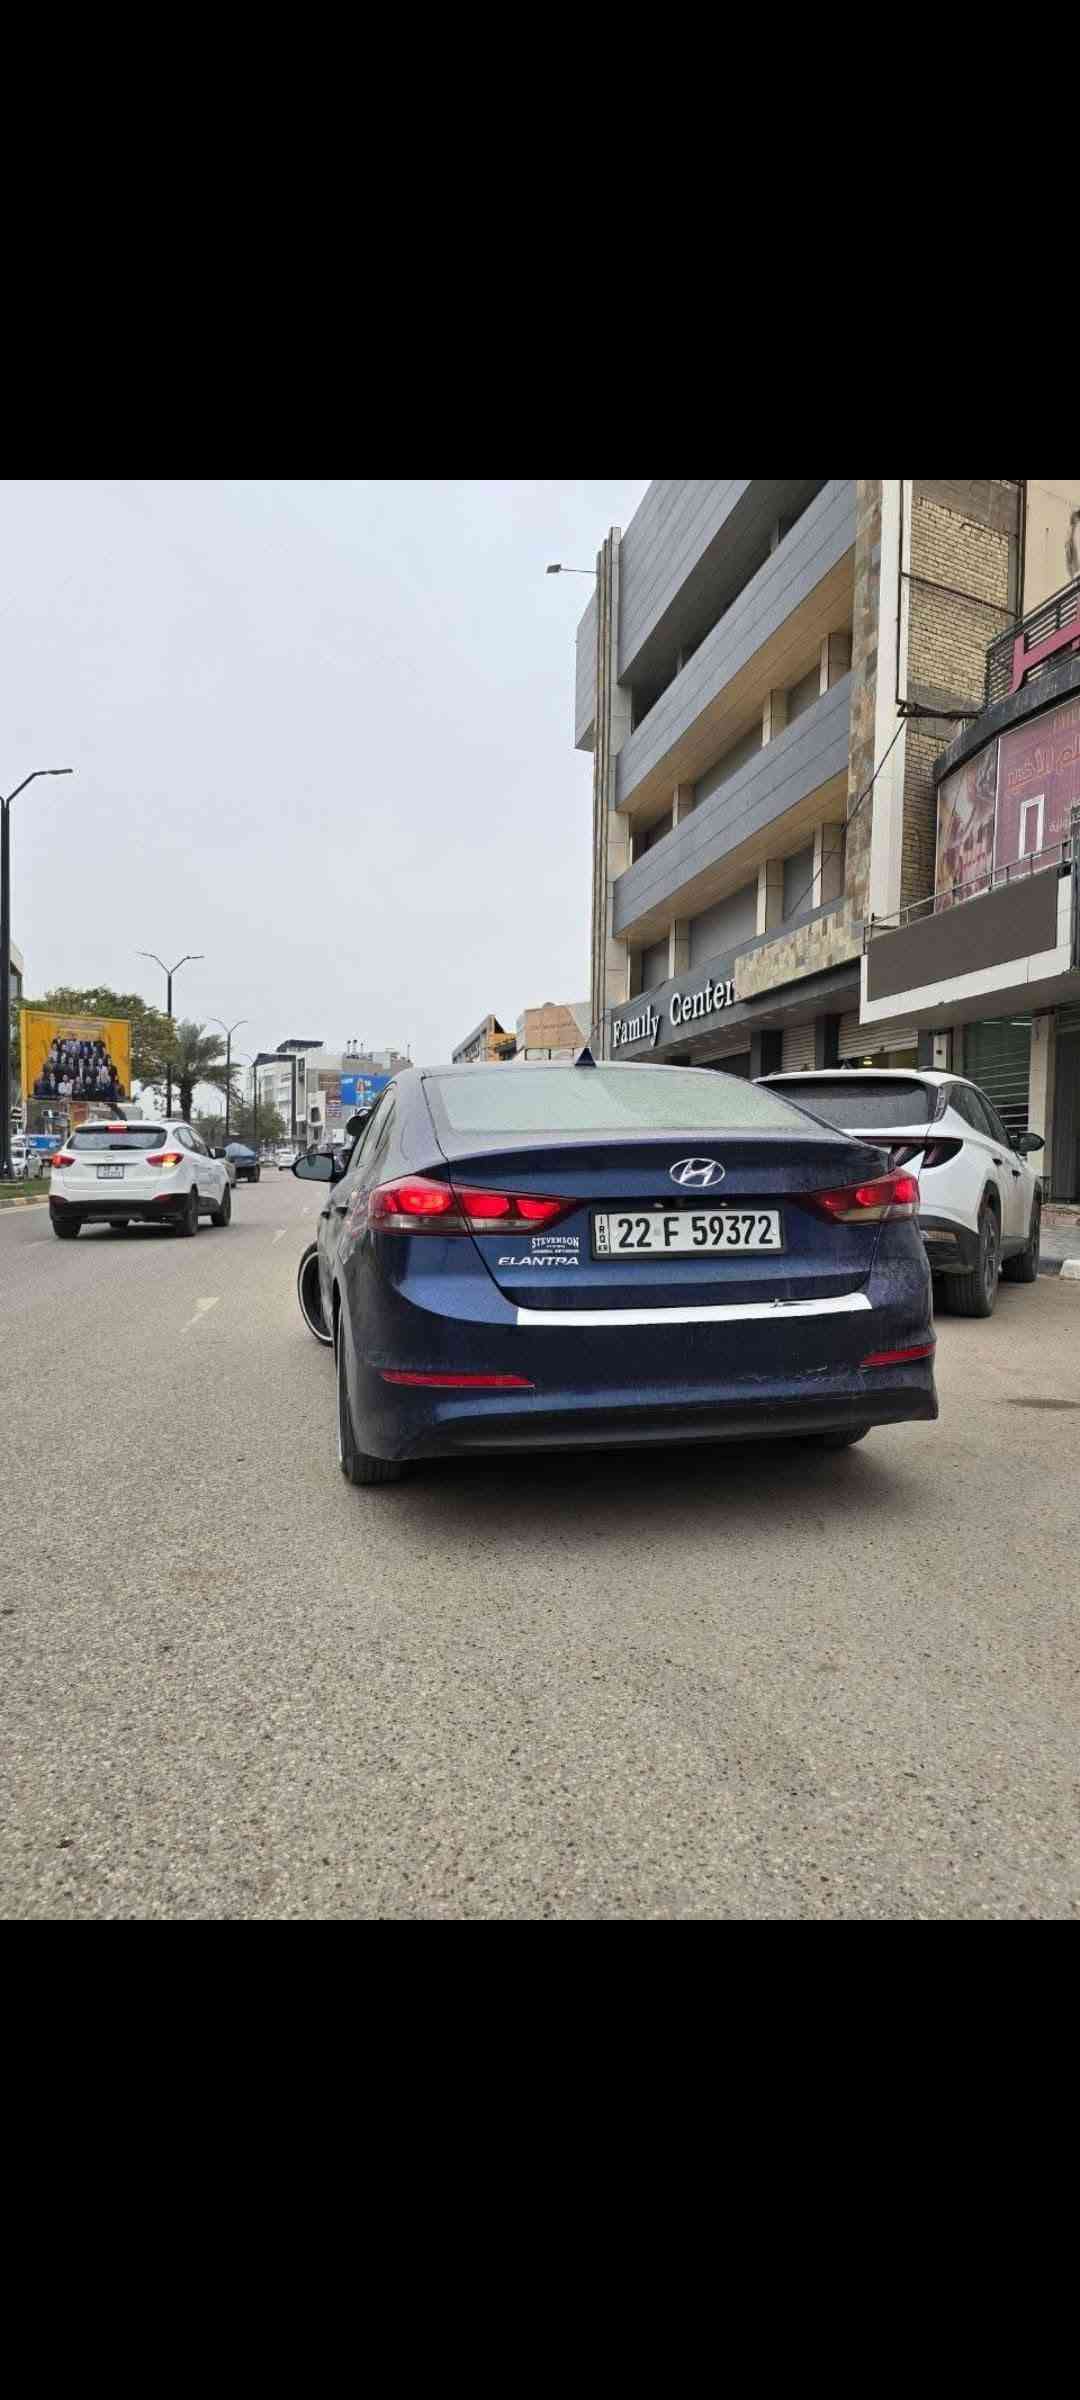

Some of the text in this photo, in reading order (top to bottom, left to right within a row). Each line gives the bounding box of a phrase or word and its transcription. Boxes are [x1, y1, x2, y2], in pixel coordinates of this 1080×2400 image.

[612, 978, 737, 1048] Family Center
[531, 1236, 580, 1249] STEVENSON
[617, 1215, 773, 1248] 22 F 59372
[498, 1256, 580, 1266] ELANTRA
